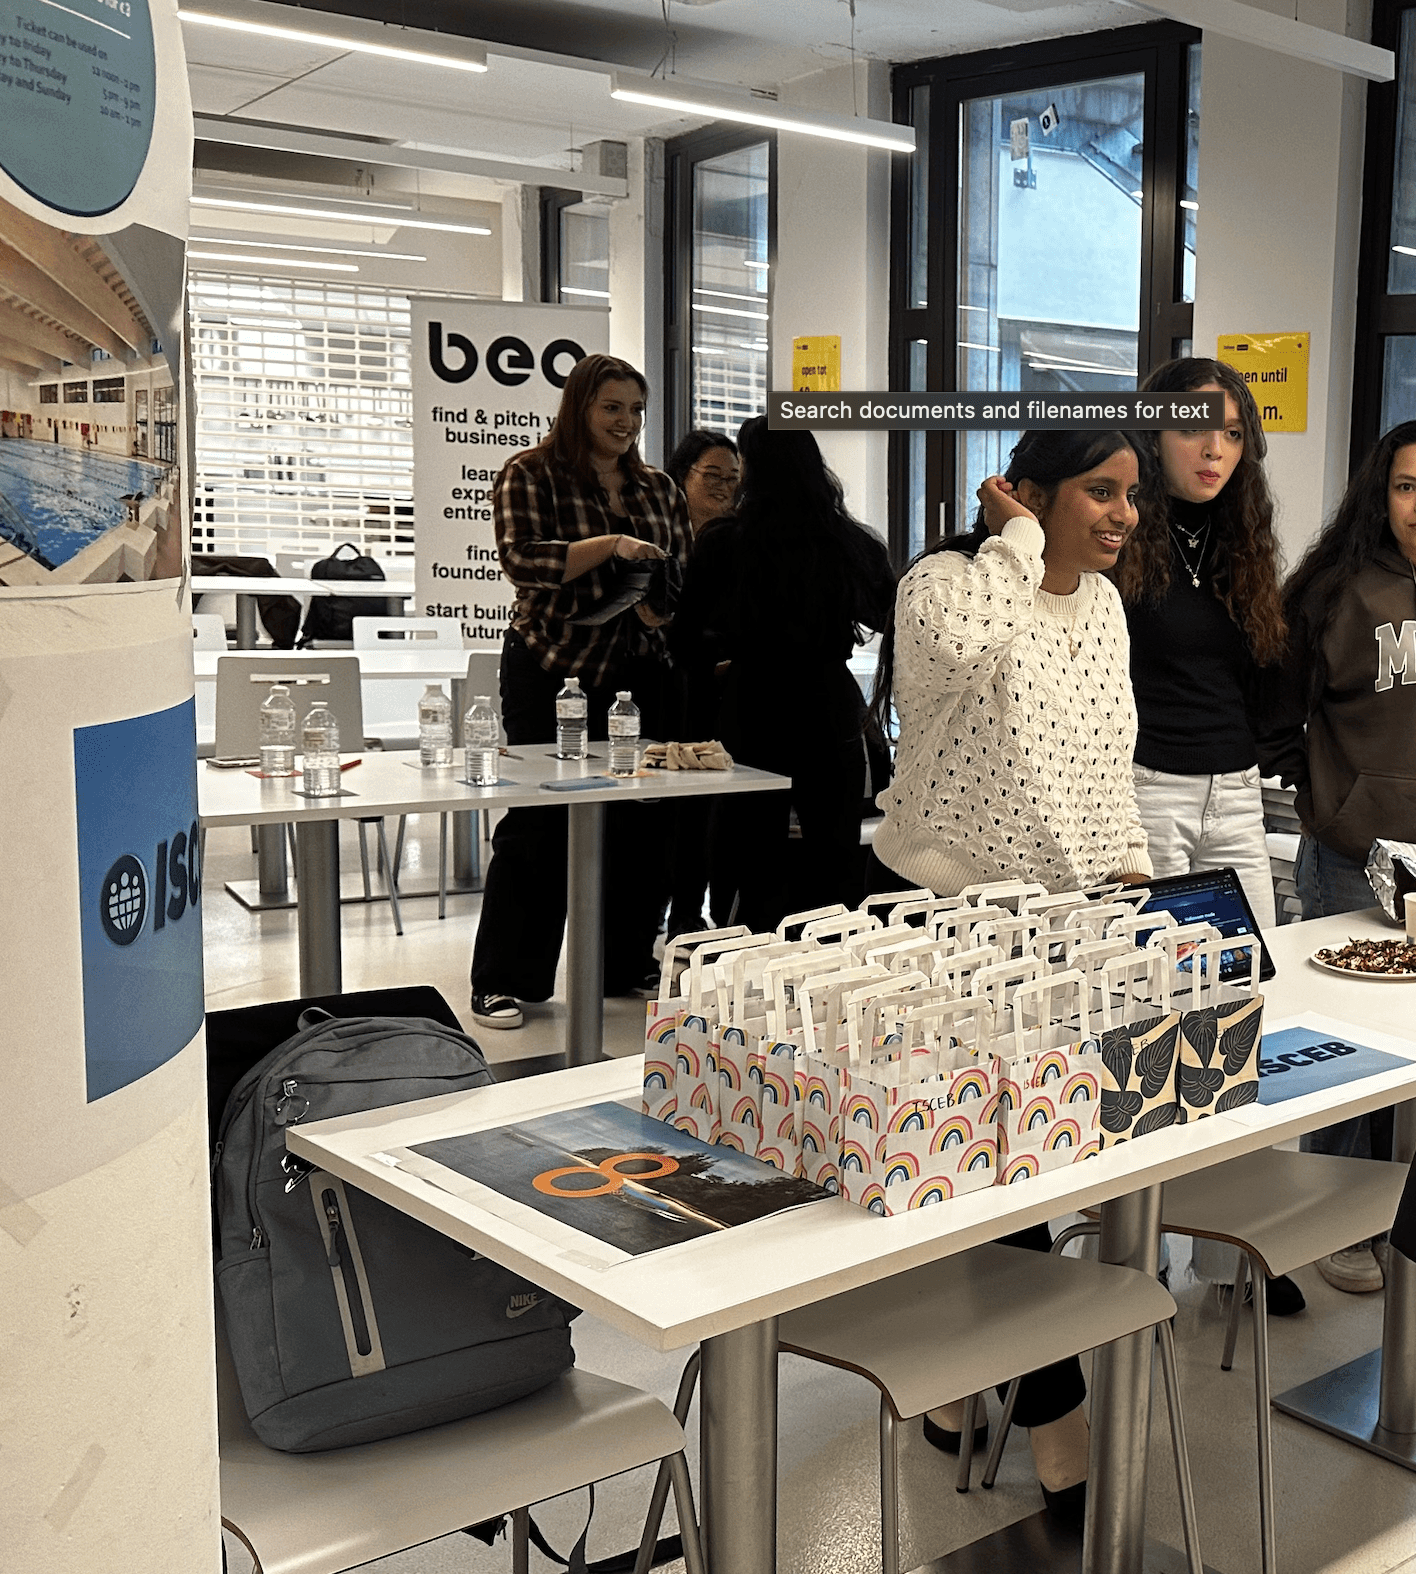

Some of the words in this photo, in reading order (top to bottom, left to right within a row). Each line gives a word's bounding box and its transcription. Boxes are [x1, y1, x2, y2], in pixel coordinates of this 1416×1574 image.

[36, 81, 72, 106] Sunday
[1261, 367, 1287, 383] until
[431, 406, 468, 423] find
[474, 409, 488, 425] &
[494, 410, 541, 430] pitch
[445, 427, 531, 447] business
[425, 603, 469, 619] start
[911, 1092, 956, 1113] ISCEB
[510, 1292, 538, 1308] NIKE
